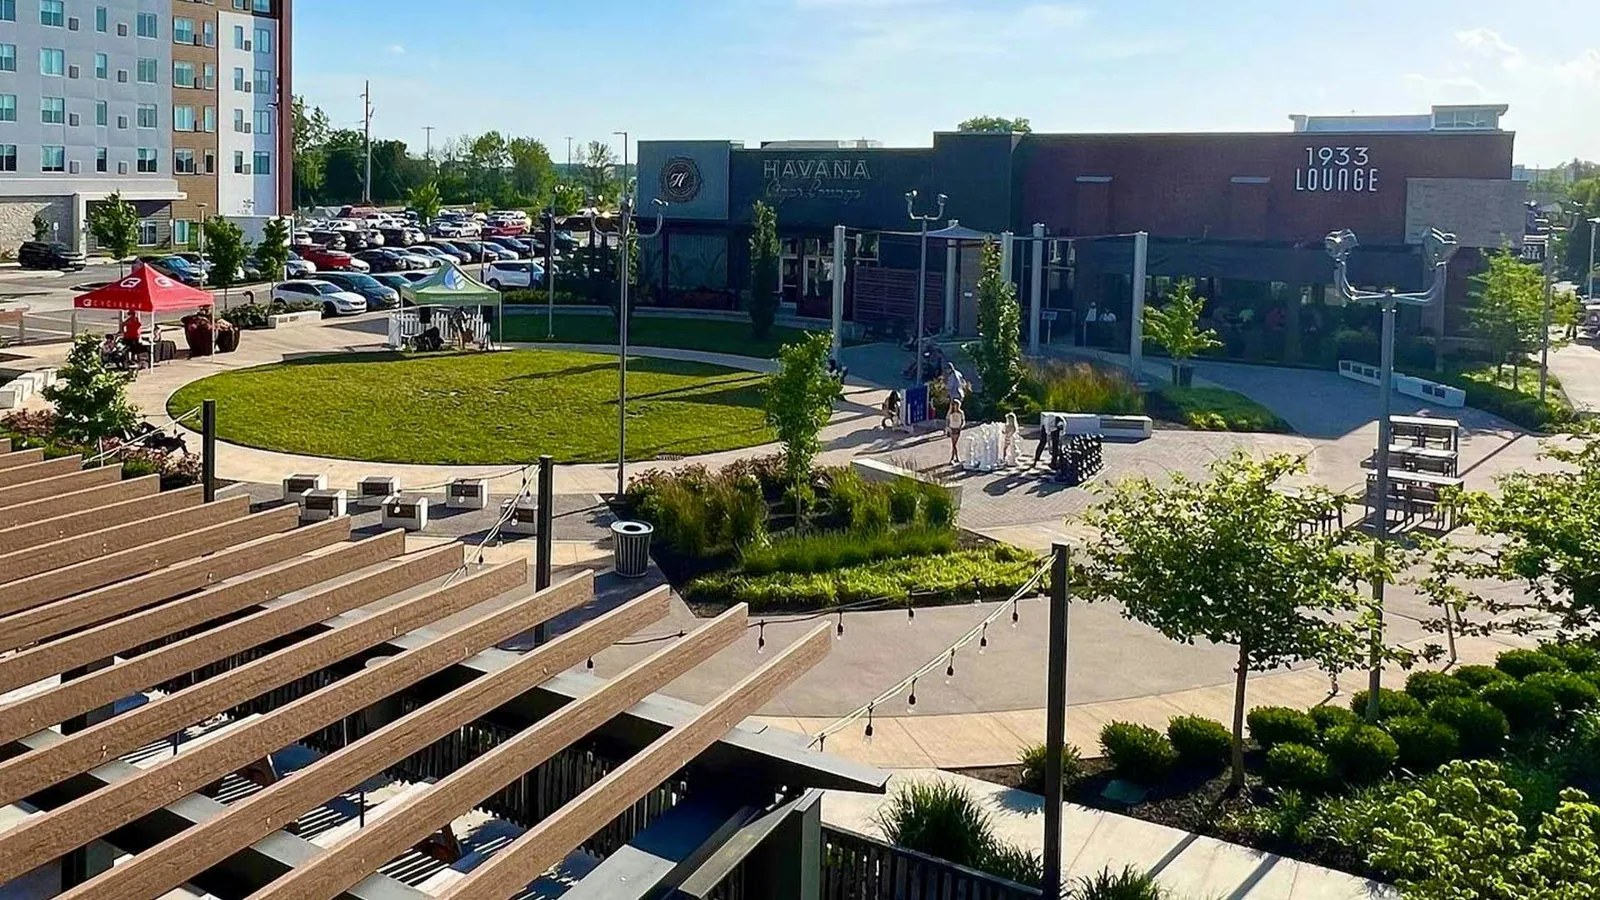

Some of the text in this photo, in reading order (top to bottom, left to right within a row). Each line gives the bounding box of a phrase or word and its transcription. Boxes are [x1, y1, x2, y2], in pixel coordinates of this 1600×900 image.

[1306, 147, 1369, 165] 1933
[763, 160, 871, 179] HAVANA
[1296, 168, 1378, 191] LOUNGE
